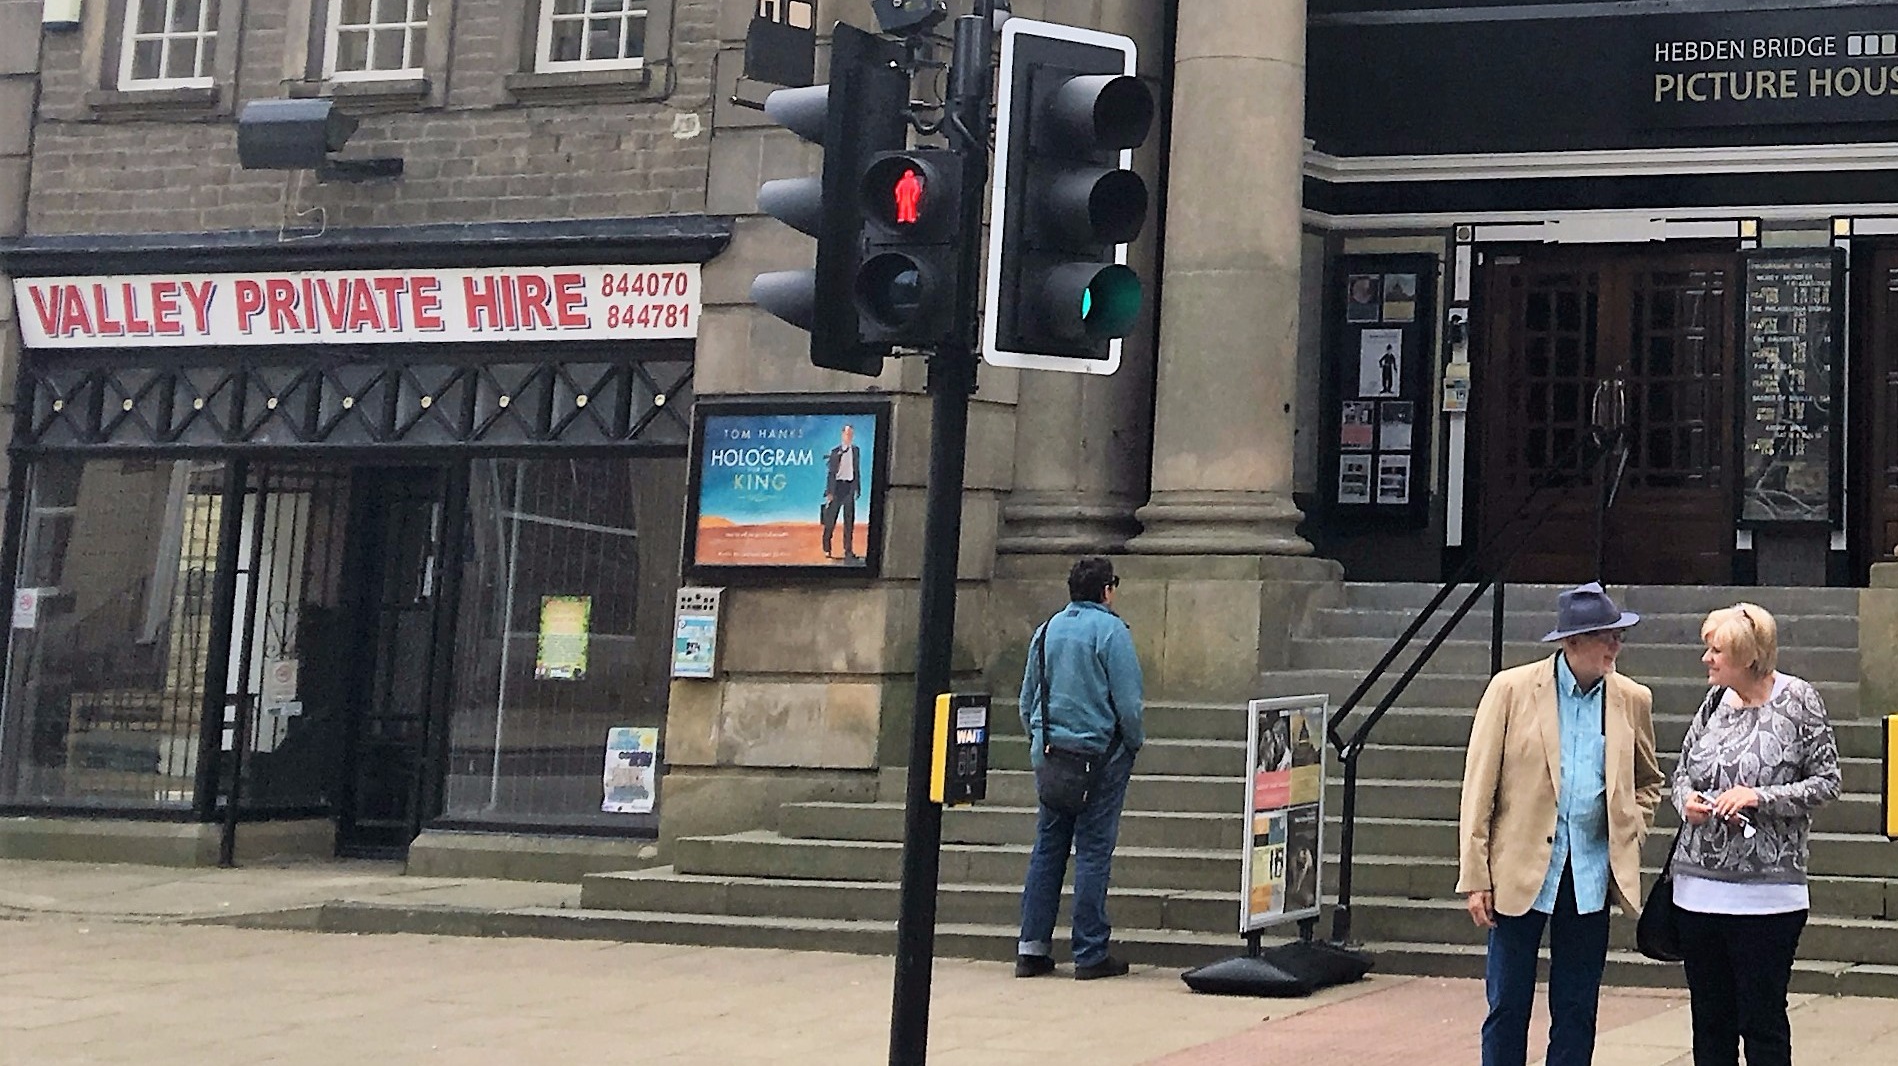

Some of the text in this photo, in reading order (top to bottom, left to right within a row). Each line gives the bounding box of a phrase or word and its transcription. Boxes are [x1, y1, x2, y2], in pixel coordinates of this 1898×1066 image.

[1655, 36, 1837, 63] HEBDEN BRIDGE
[1655, 70, 1798, 102] PICTURE
[602, 271, 688, 297] 844070
[28, 272, 592, 337] VALLEY PRIVATE HIRE
[607, 302, 689, 329] 844781
[724, 428, 803, 439] TOM HANKS
[711, 448, 814, 467] HOLOGRAM
[733, 473, 787, 491] KING
